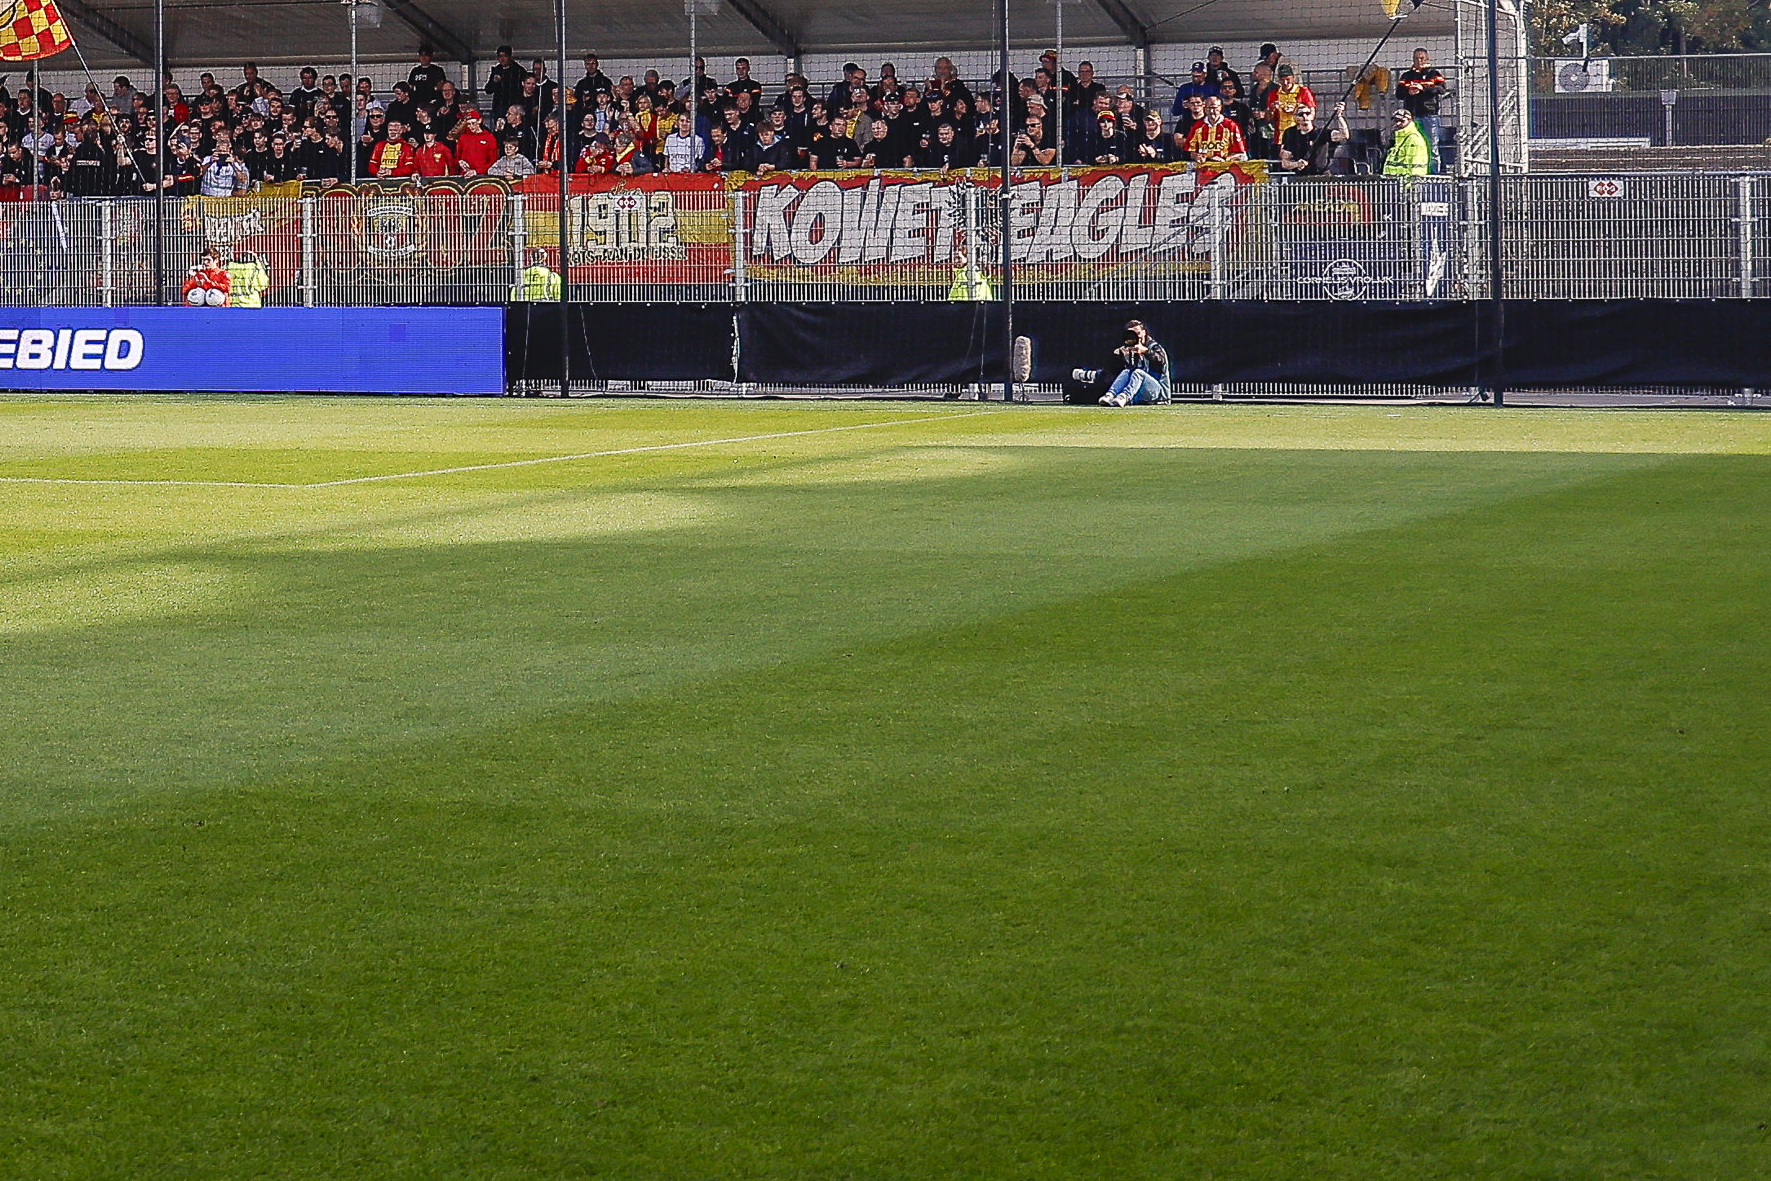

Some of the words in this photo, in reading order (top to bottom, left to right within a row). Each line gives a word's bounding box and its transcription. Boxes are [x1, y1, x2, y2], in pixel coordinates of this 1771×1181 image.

[566, 190, 680, 251] 1902
[751, 178, 956, 266] KOWET
[1009, 172, 1236, 264] EAGLES
